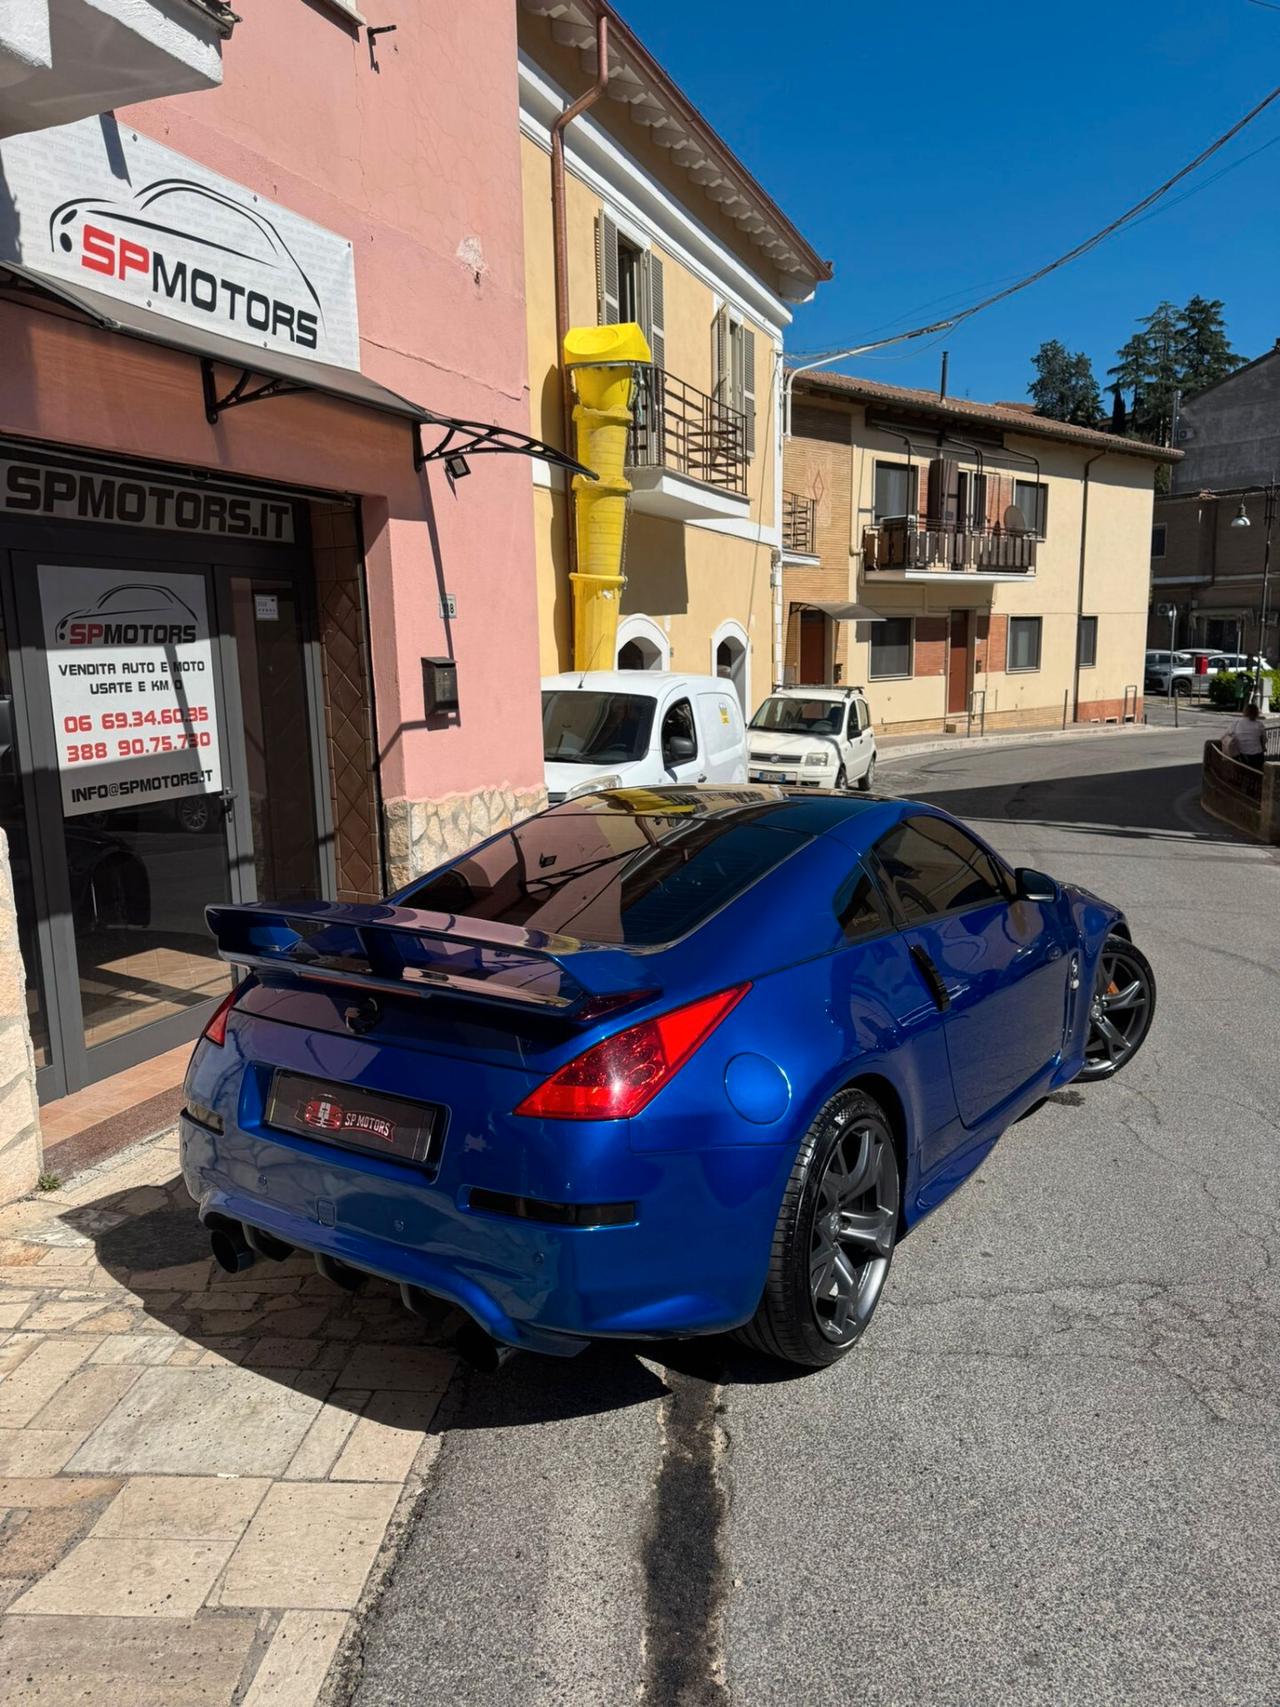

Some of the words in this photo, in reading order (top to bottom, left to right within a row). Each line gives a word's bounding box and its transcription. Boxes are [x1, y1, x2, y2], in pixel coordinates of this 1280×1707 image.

[81, 223, 318, 350] SPMOTORS
[5, 465, 290, 539] SPMOTORS.IT
[69, 623, 196, 645] SPMOTORS
[58, 663, 116, 676] VENDITA
[122, 662, 155, 674] AUTO
[161, 662, 169, 673] E
[173, 661, 205, 672] MOTO
[90, 681, 133, 695] USATE
[138, 681, 146, 692] E
[151, 680, 169, 691] KM
[64, 715, 92, 733] 06
[101, 706, 209, 730] 69.34.60.35
[66, 742, 108, 763] 388
[118, 732, 211, 756] 90.75.730
[71, 769, 213, 803] INFO@SPMOTORS.IT
[345, 1113, 357, 1126] SP
[357, 1115, 390, 1137] MOTORS
